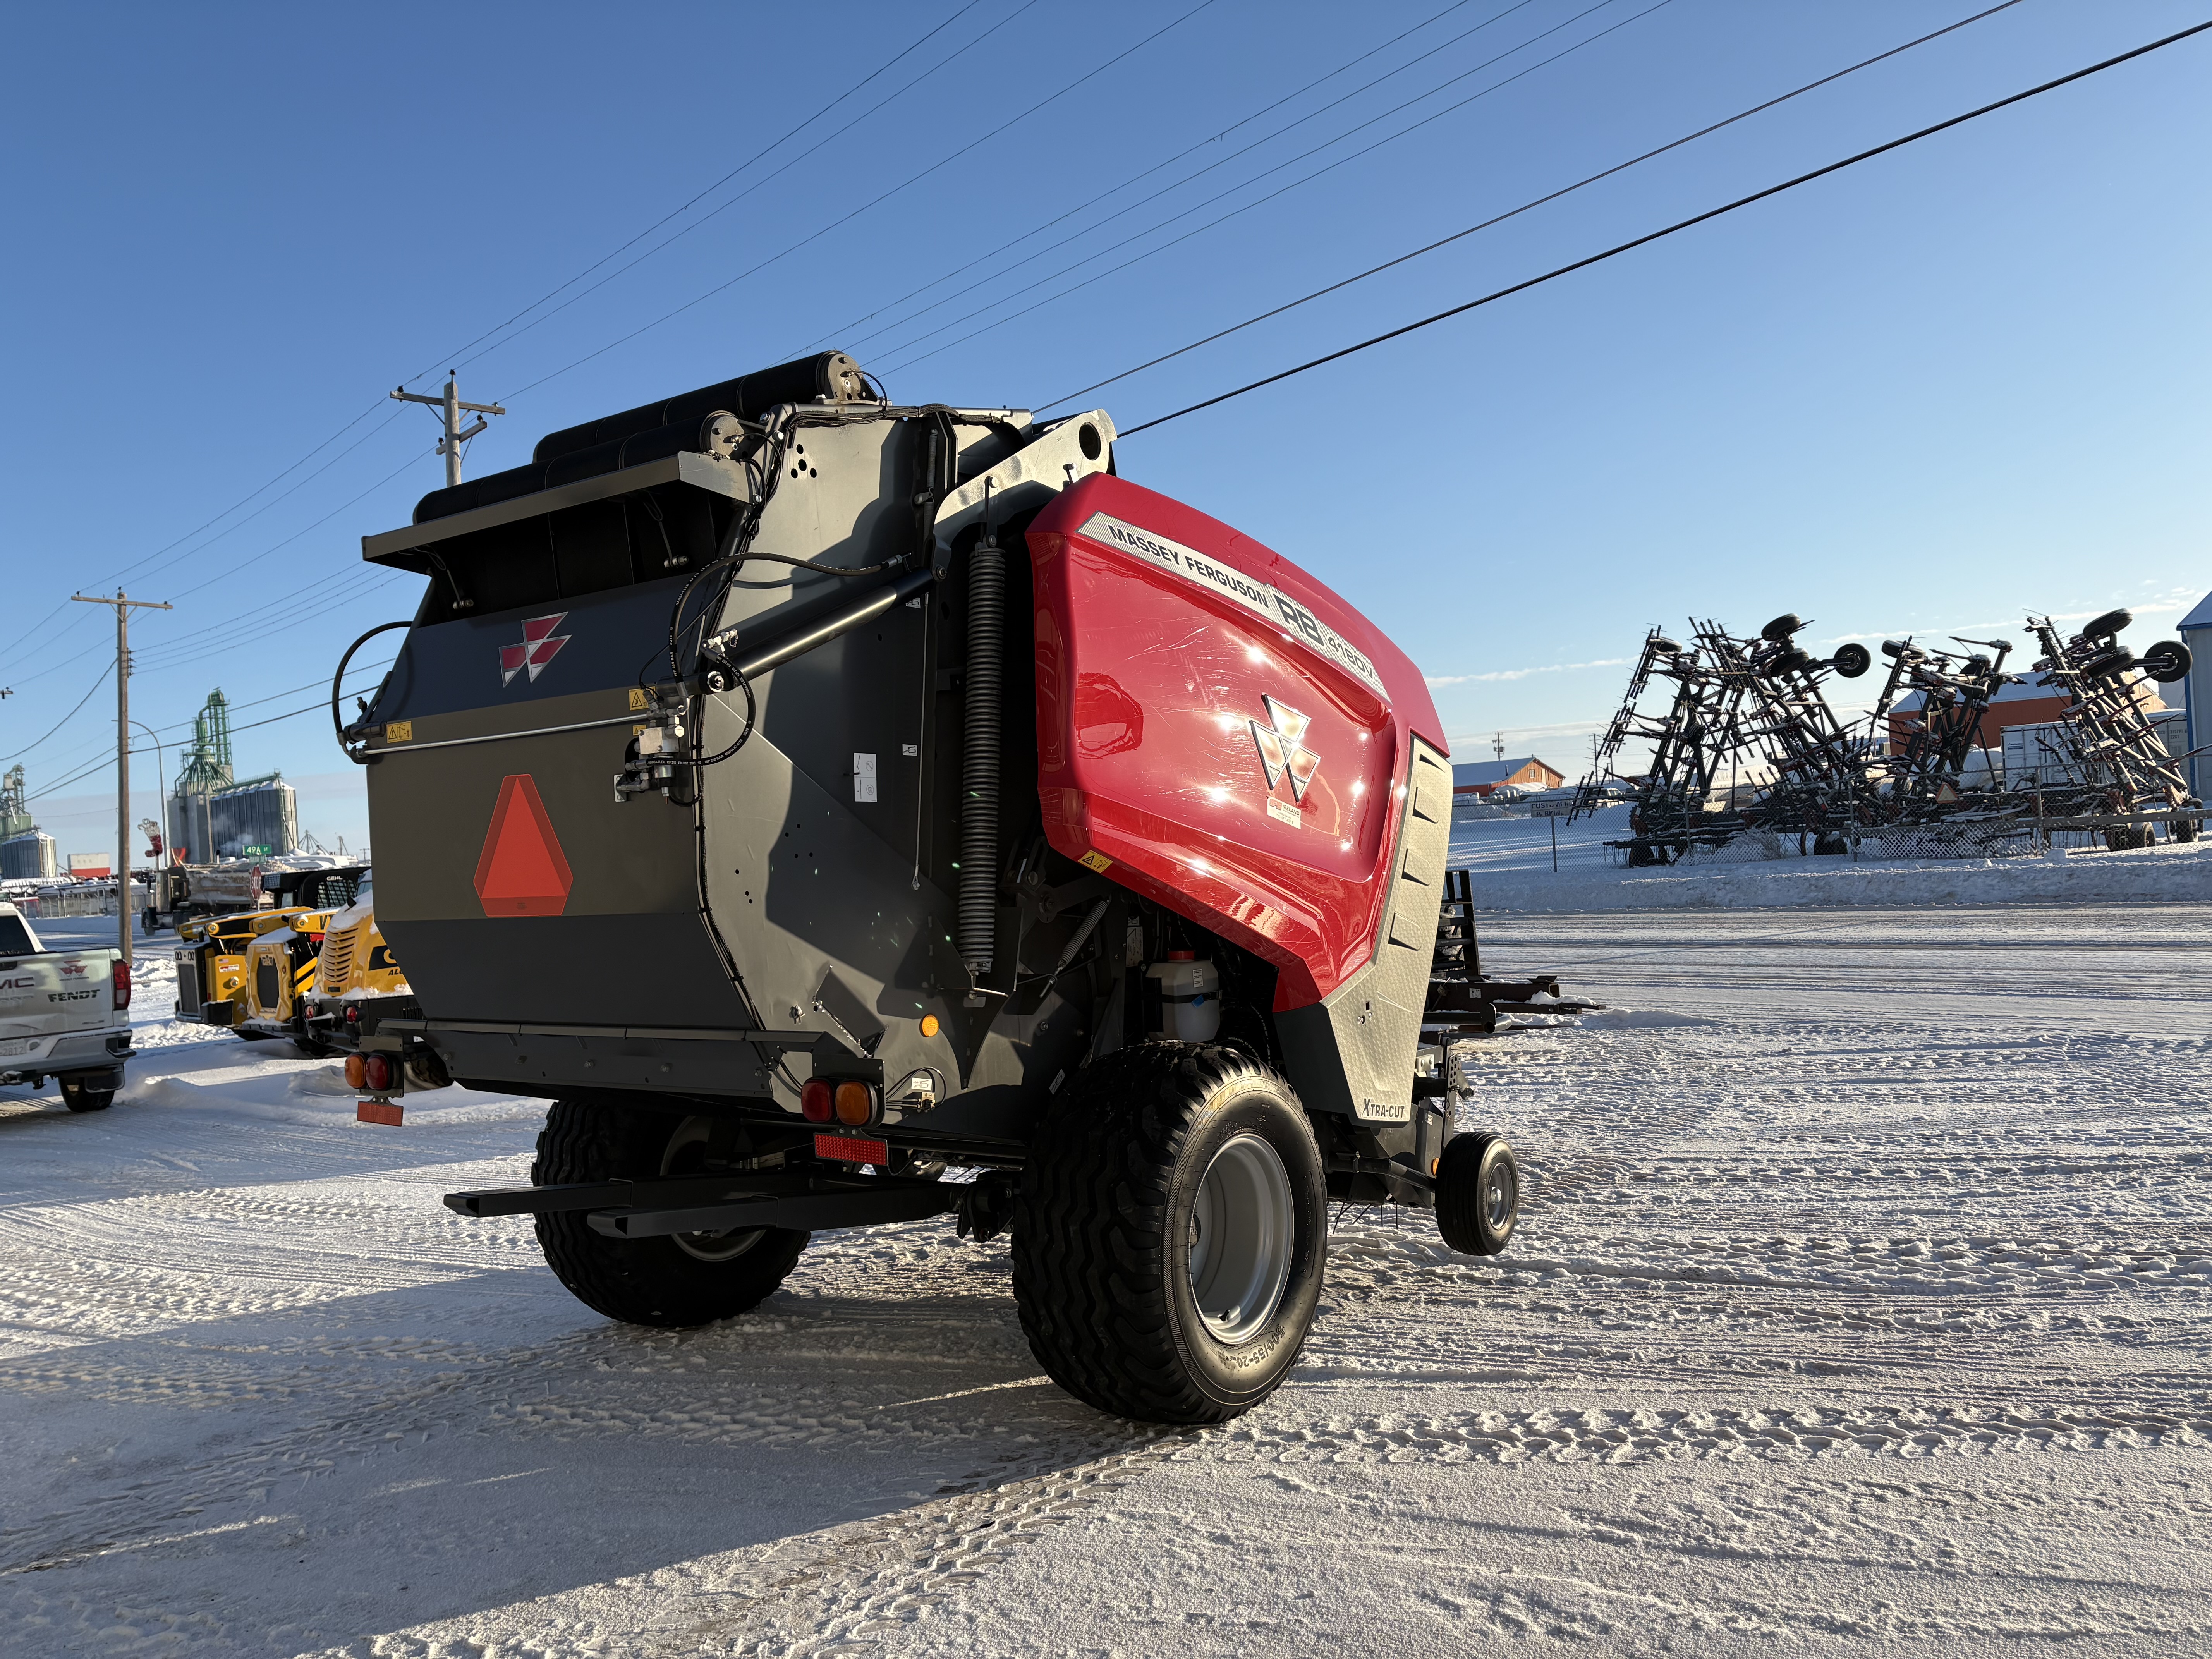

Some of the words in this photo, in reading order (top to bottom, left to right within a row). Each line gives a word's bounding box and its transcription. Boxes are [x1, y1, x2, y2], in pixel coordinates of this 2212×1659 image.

[1107, 524, 1180, 565] MASSEY
[1184, 555, 1269, 608] FERGUSON
[1272, 592, 1324, 647] RB
[1328, 636, 1373, 679] 4180V
[1283, 804, 1300, 816] IRELAND
[247, 846, 261, 855] 49A
[251, 876, 261, 890] STOP
[47, 989, 100, 1002] FENDT
[1362, 1098, 1405, 1118] XTRA-CUT
